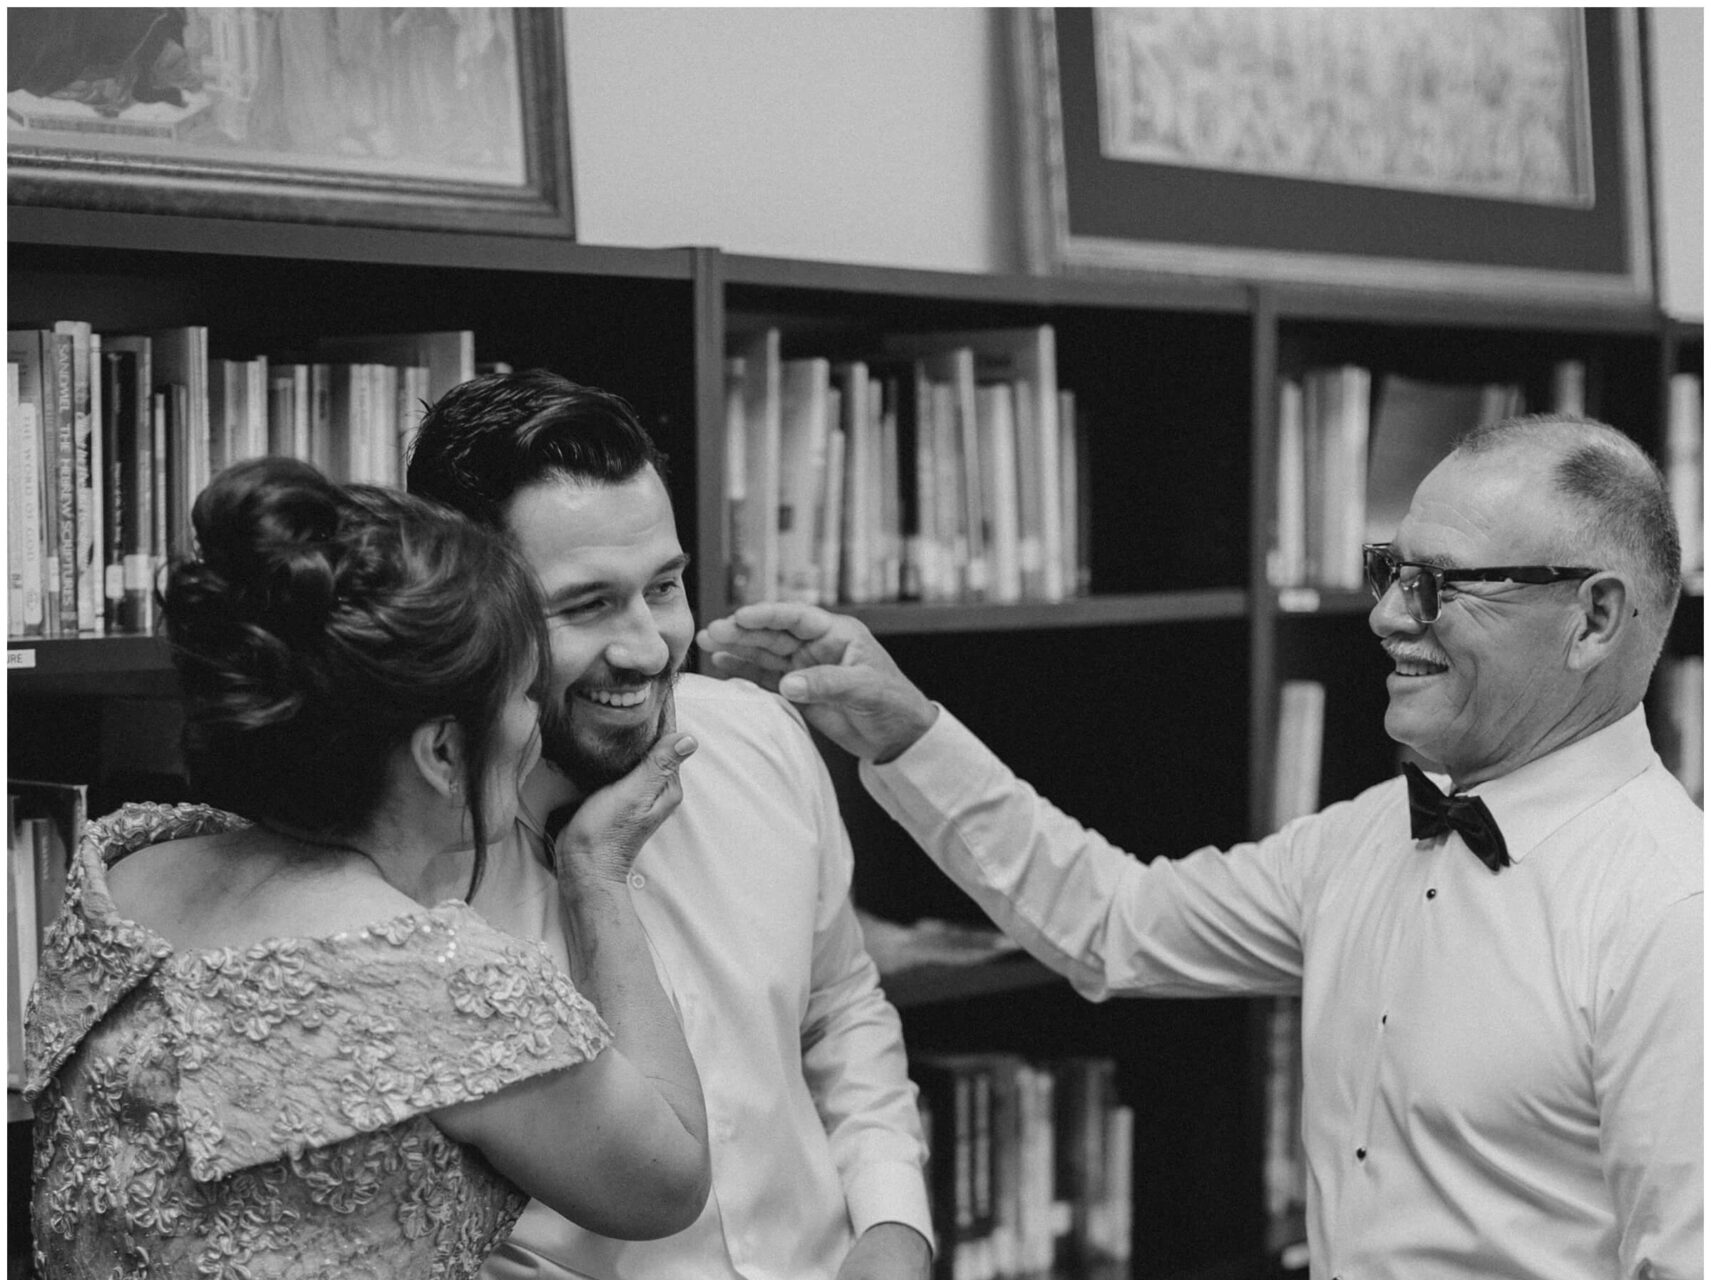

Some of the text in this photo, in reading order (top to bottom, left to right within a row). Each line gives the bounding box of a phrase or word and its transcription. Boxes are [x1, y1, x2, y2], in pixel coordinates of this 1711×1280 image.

[59, 343, 74, 606] SANDMEL THE HEBREW SCRIPTURES
